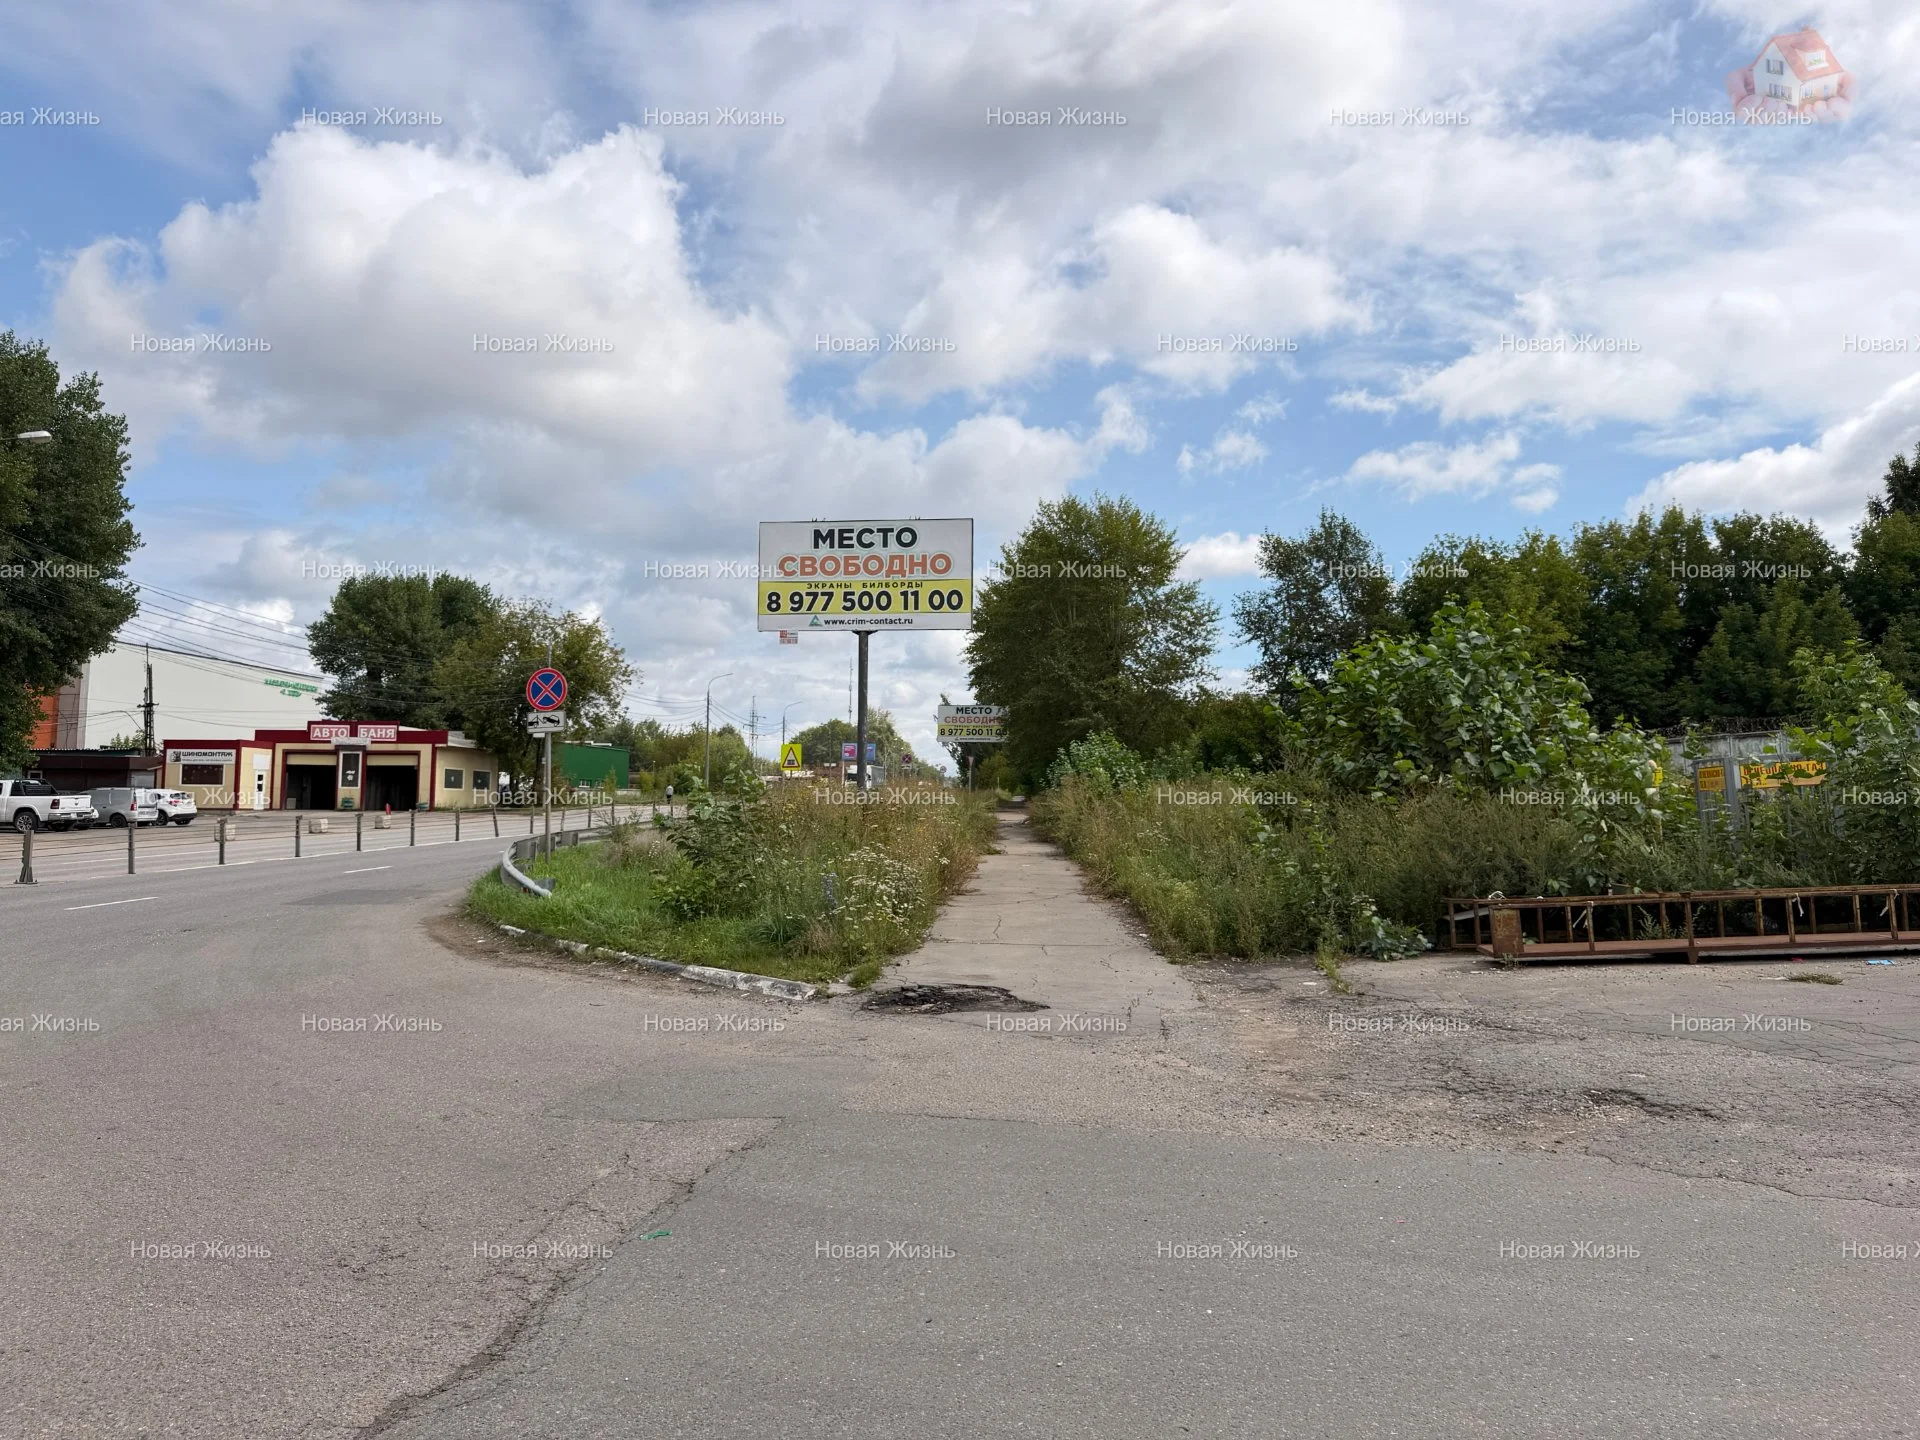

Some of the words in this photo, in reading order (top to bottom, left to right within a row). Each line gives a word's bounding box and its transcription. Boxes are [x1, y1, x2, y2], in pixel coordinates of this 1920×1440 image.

[813, 527, 918, 549] МЕСТО
[778, 554, 952, 578] СВОБОДНО
[862, 581, 923, 589] БИЛБОРДЫ
[767, 592, 781, 612] 8
[789, 592, 834, 612] 977
[842, 591, 892, 611] 500
[900, 590, 919, 610] 11
[928, 590, 963, 610] 00
[956, 706, 992, 715] МЕСТО
[313, 728, 347, 738] АВТО
[360, 728, 396, 739] БАНЯ
[940, 728, 945, 736] 8
[948, 728, 963, 736] 977
[966, 728, 983, 736] 500
[986, 728, 993, 736] 11
